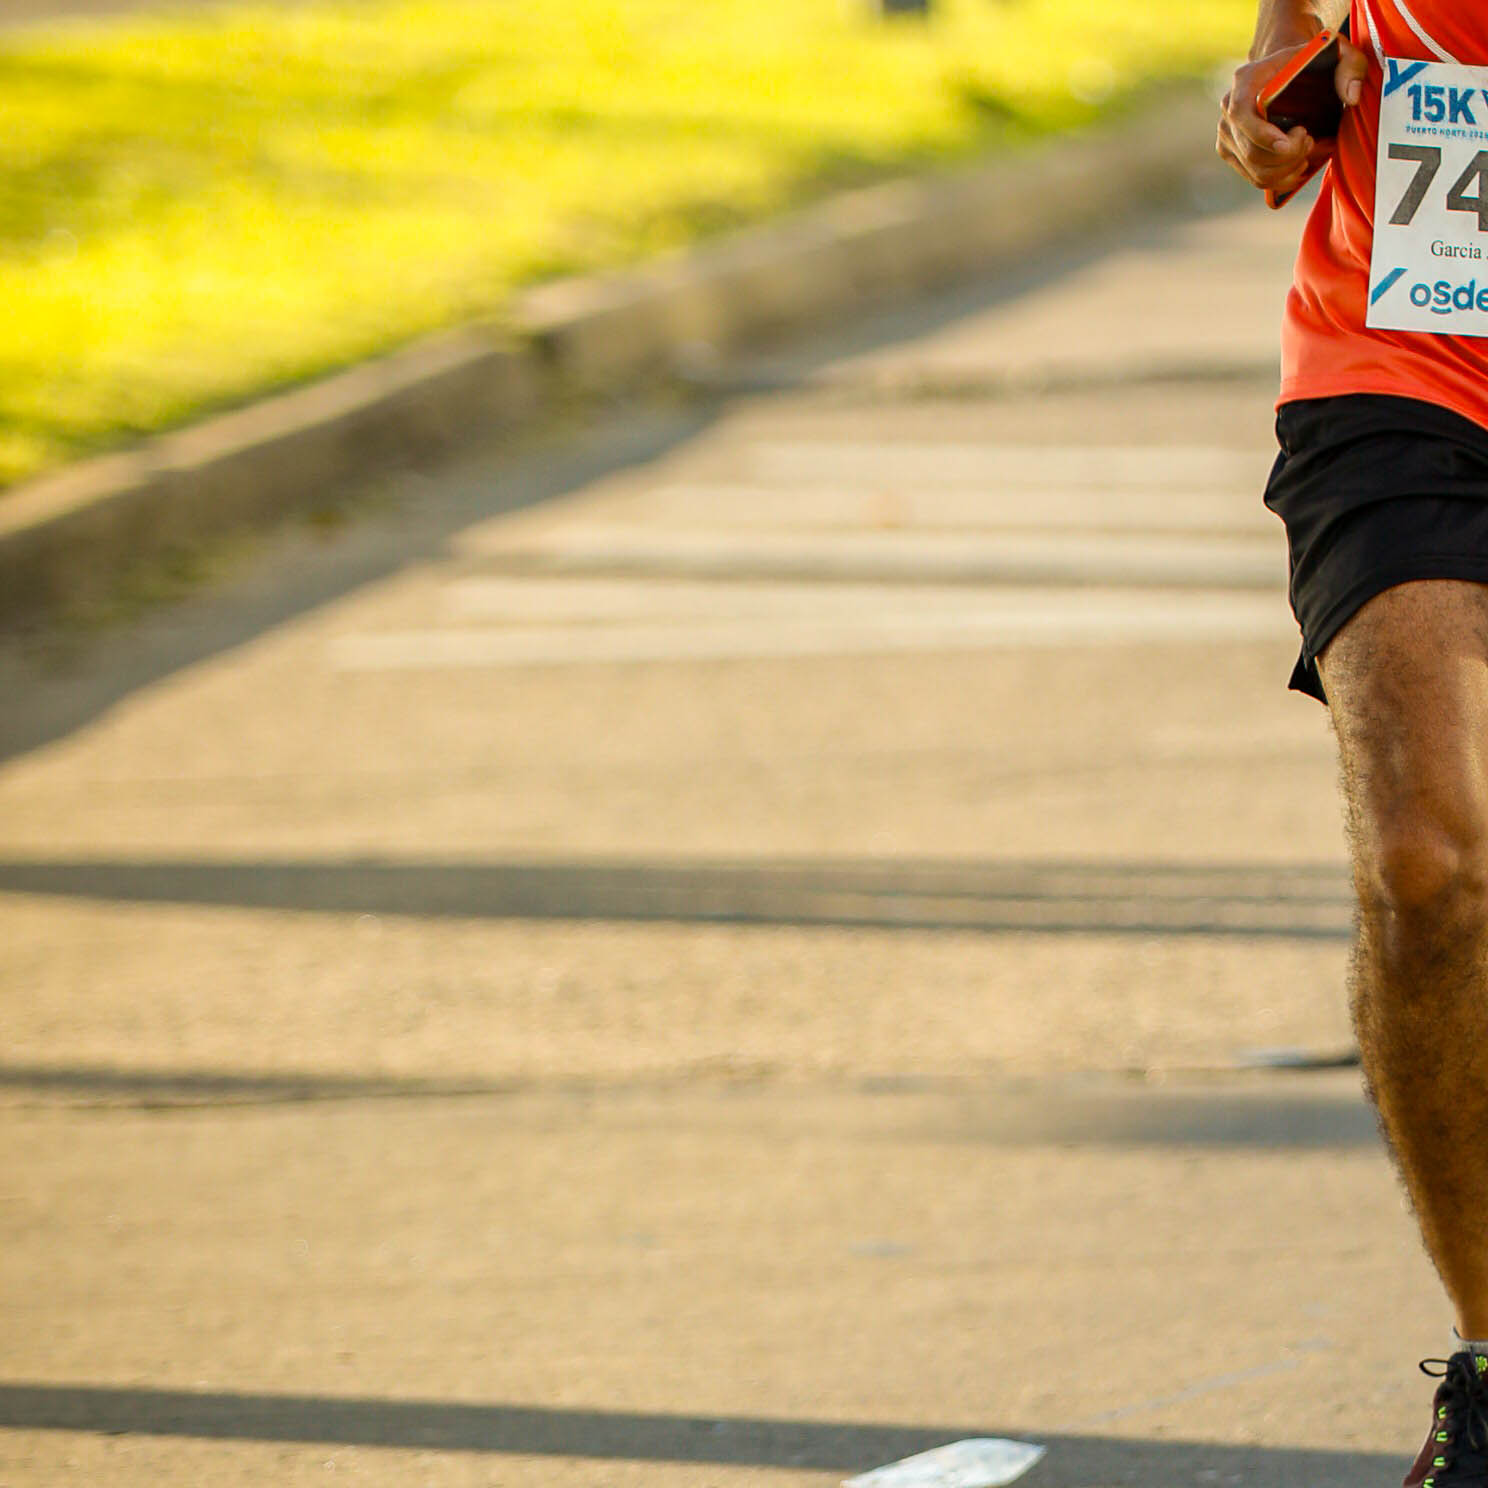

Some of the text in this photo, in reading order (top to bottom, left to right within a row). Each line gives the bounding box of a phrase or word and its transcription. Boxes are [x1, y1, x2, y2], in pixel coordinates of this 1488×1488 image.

[1407, 83, 1476, 124] 15K
[1406, 125, 1437, 135] PUERTO
[1440, 128, 1466, 137] NORTE
[1430, 240, 1482, 259] Garcia
